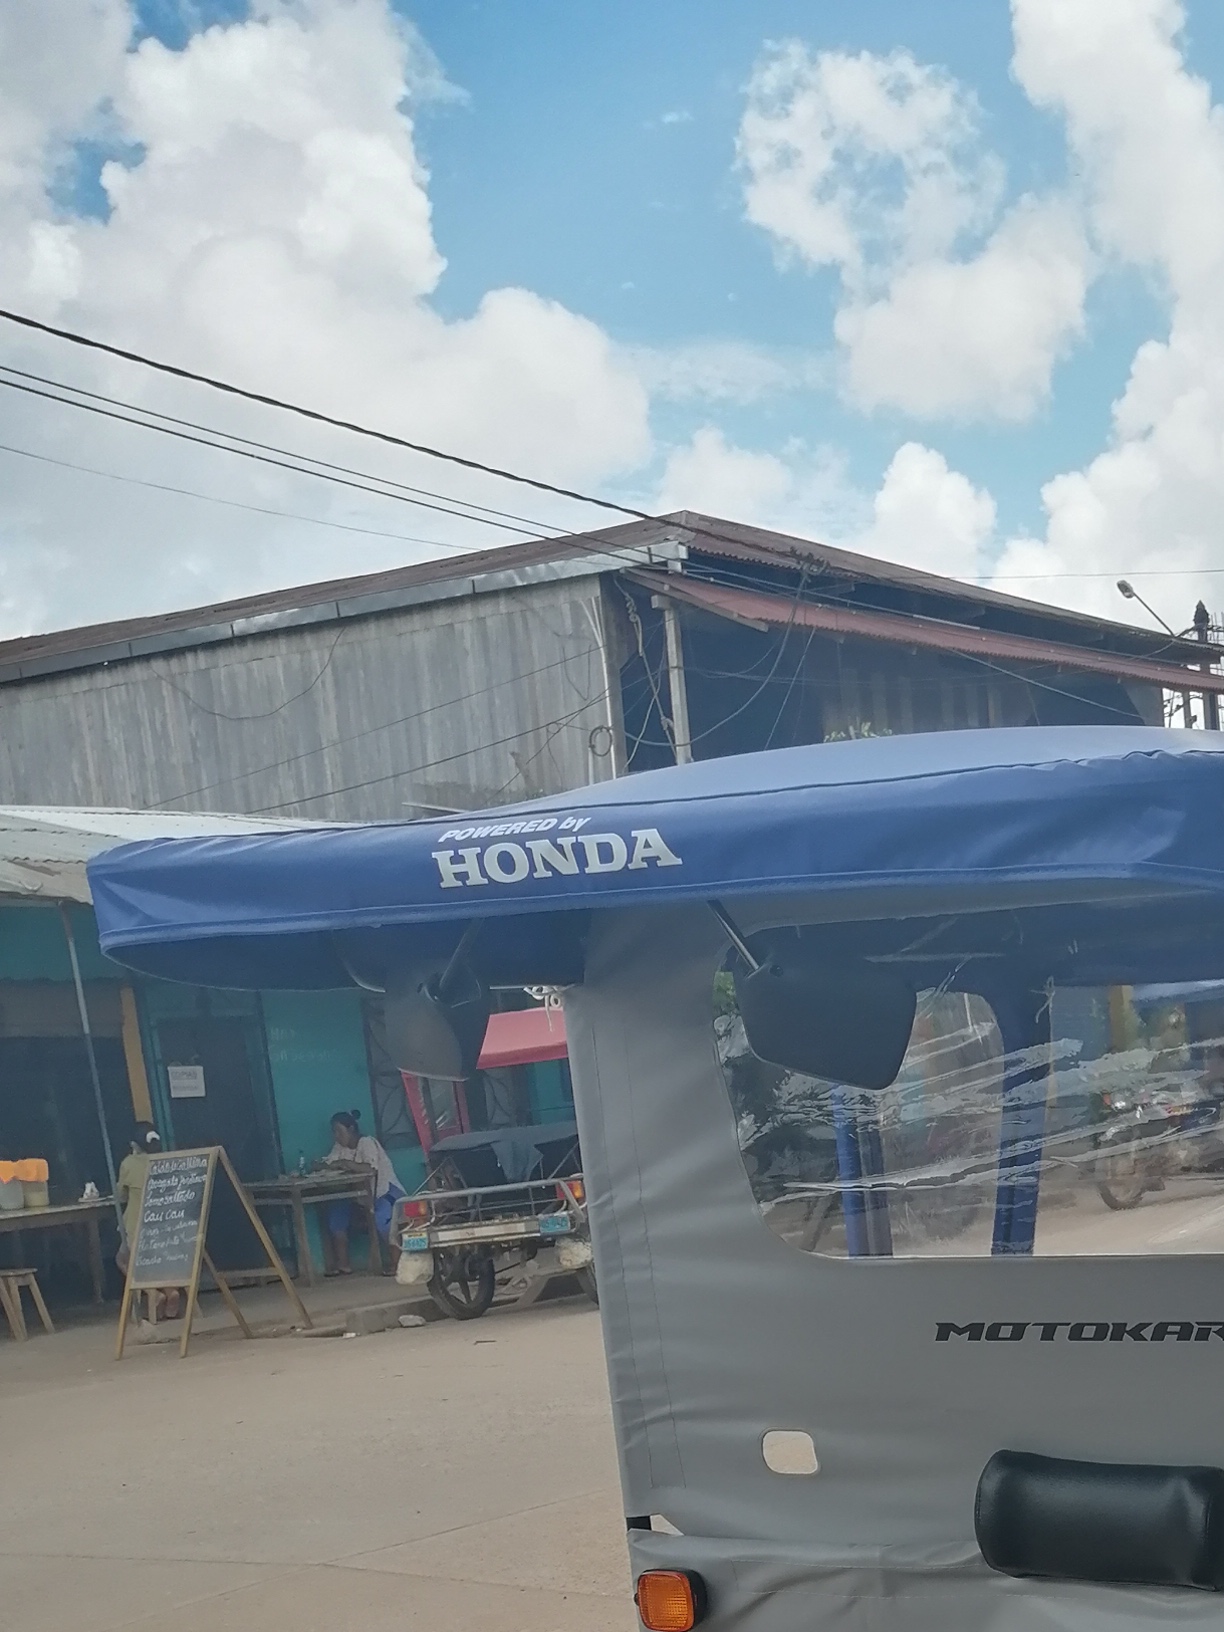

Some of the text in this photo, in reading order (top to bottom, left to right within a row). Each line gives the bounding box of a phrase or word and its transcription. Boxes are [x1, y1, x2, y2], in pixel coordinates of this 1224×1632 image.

[438, 816, 591, 843] POWERED by
[431, 828, 683, 888] HONDA
